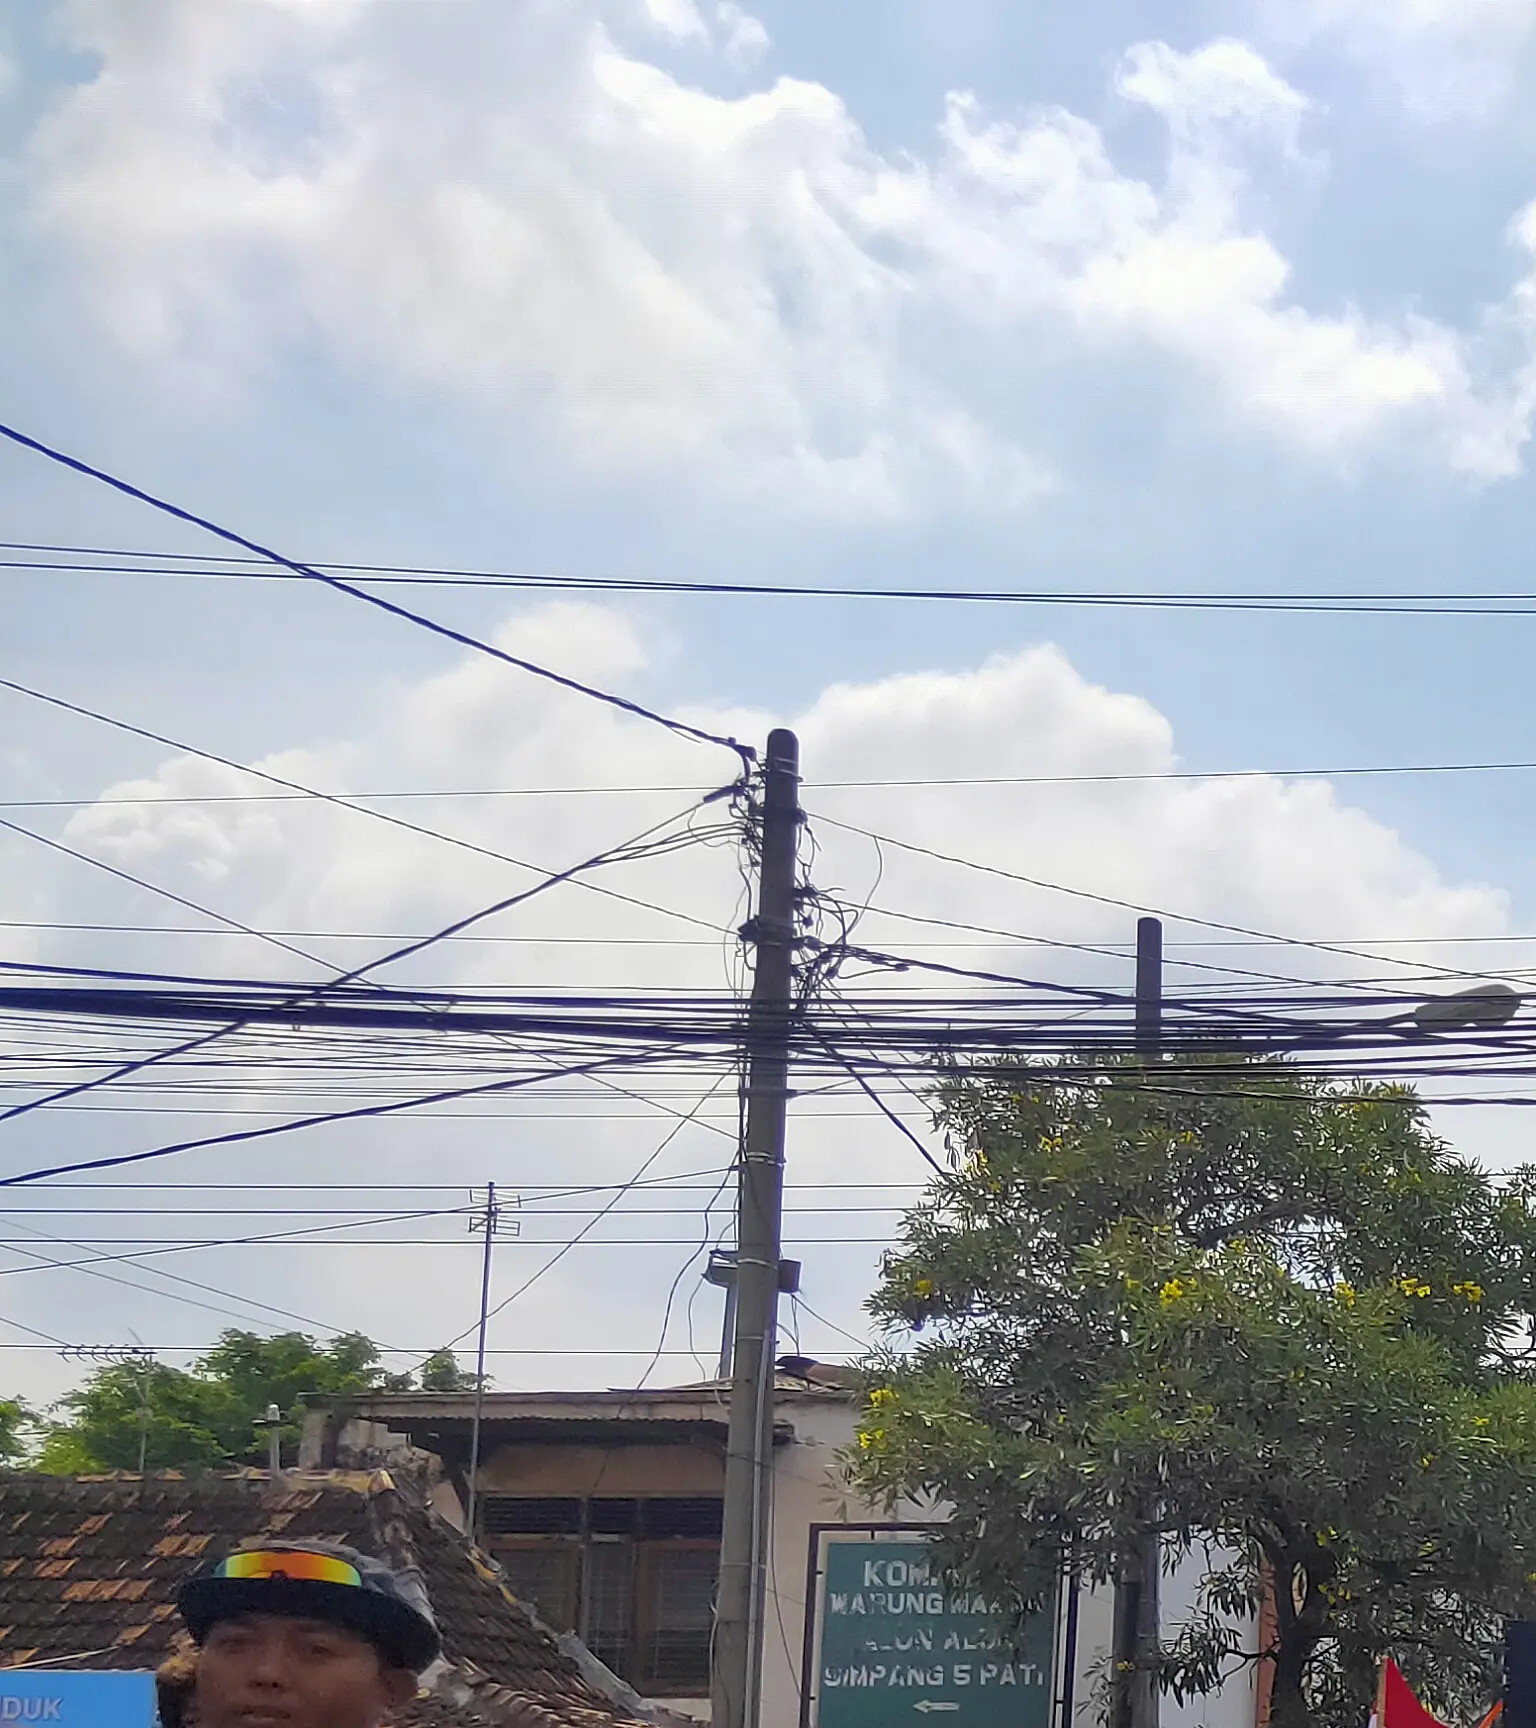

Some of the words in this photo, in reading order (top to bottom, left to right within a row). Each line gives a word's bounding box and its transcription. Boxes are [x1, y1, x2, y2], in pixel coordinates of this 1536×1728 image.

[823, 1664, 944, 1688] SIMPANG
[952, 1664, 972, 1687] 5
[0, 1696, 63, 1720] DUK
